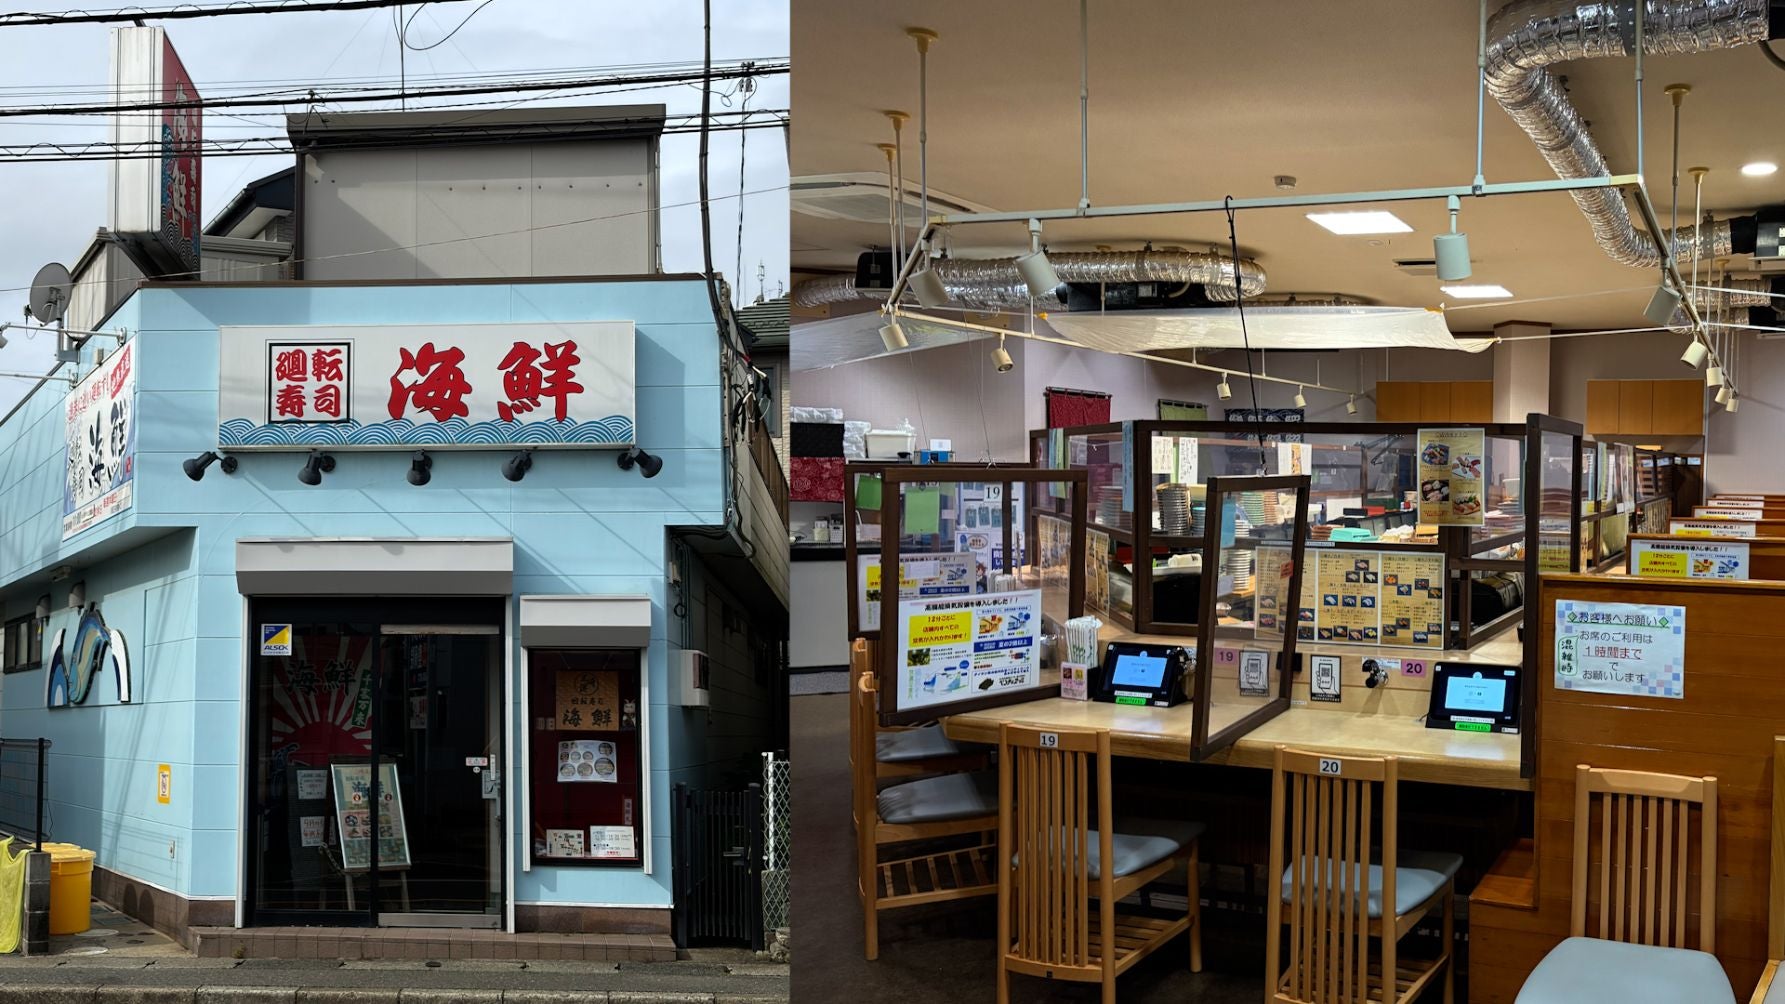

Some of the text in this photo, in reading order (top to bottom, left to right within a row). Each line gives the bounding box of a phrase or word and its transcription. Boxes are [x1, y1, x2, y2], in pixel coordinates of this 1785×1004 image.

[276, 348, 344, 382] 廻転
[387, 339, 585, 423] 海鮮
[275, 384, 342, 418] 寿司
[986, 486, 1000, 500] 19
[1578, 612, 1658, 626] お客様へお願い
[1580, 630, 1654, 644] お席のご利用は
[1218, 651, 1234, 662] 19
[1561, 639, 1574, 673] 混雑時
[1405, 662, 1423, 674] 20
[1610, 662, 1620, 672] で
[1582, 670, 1646, 684] お願いします
[562, 706, 613, 728] 海鮮
[1041, 734, 1056, 746] 19
[1322, 760, 1339, 773] 20
